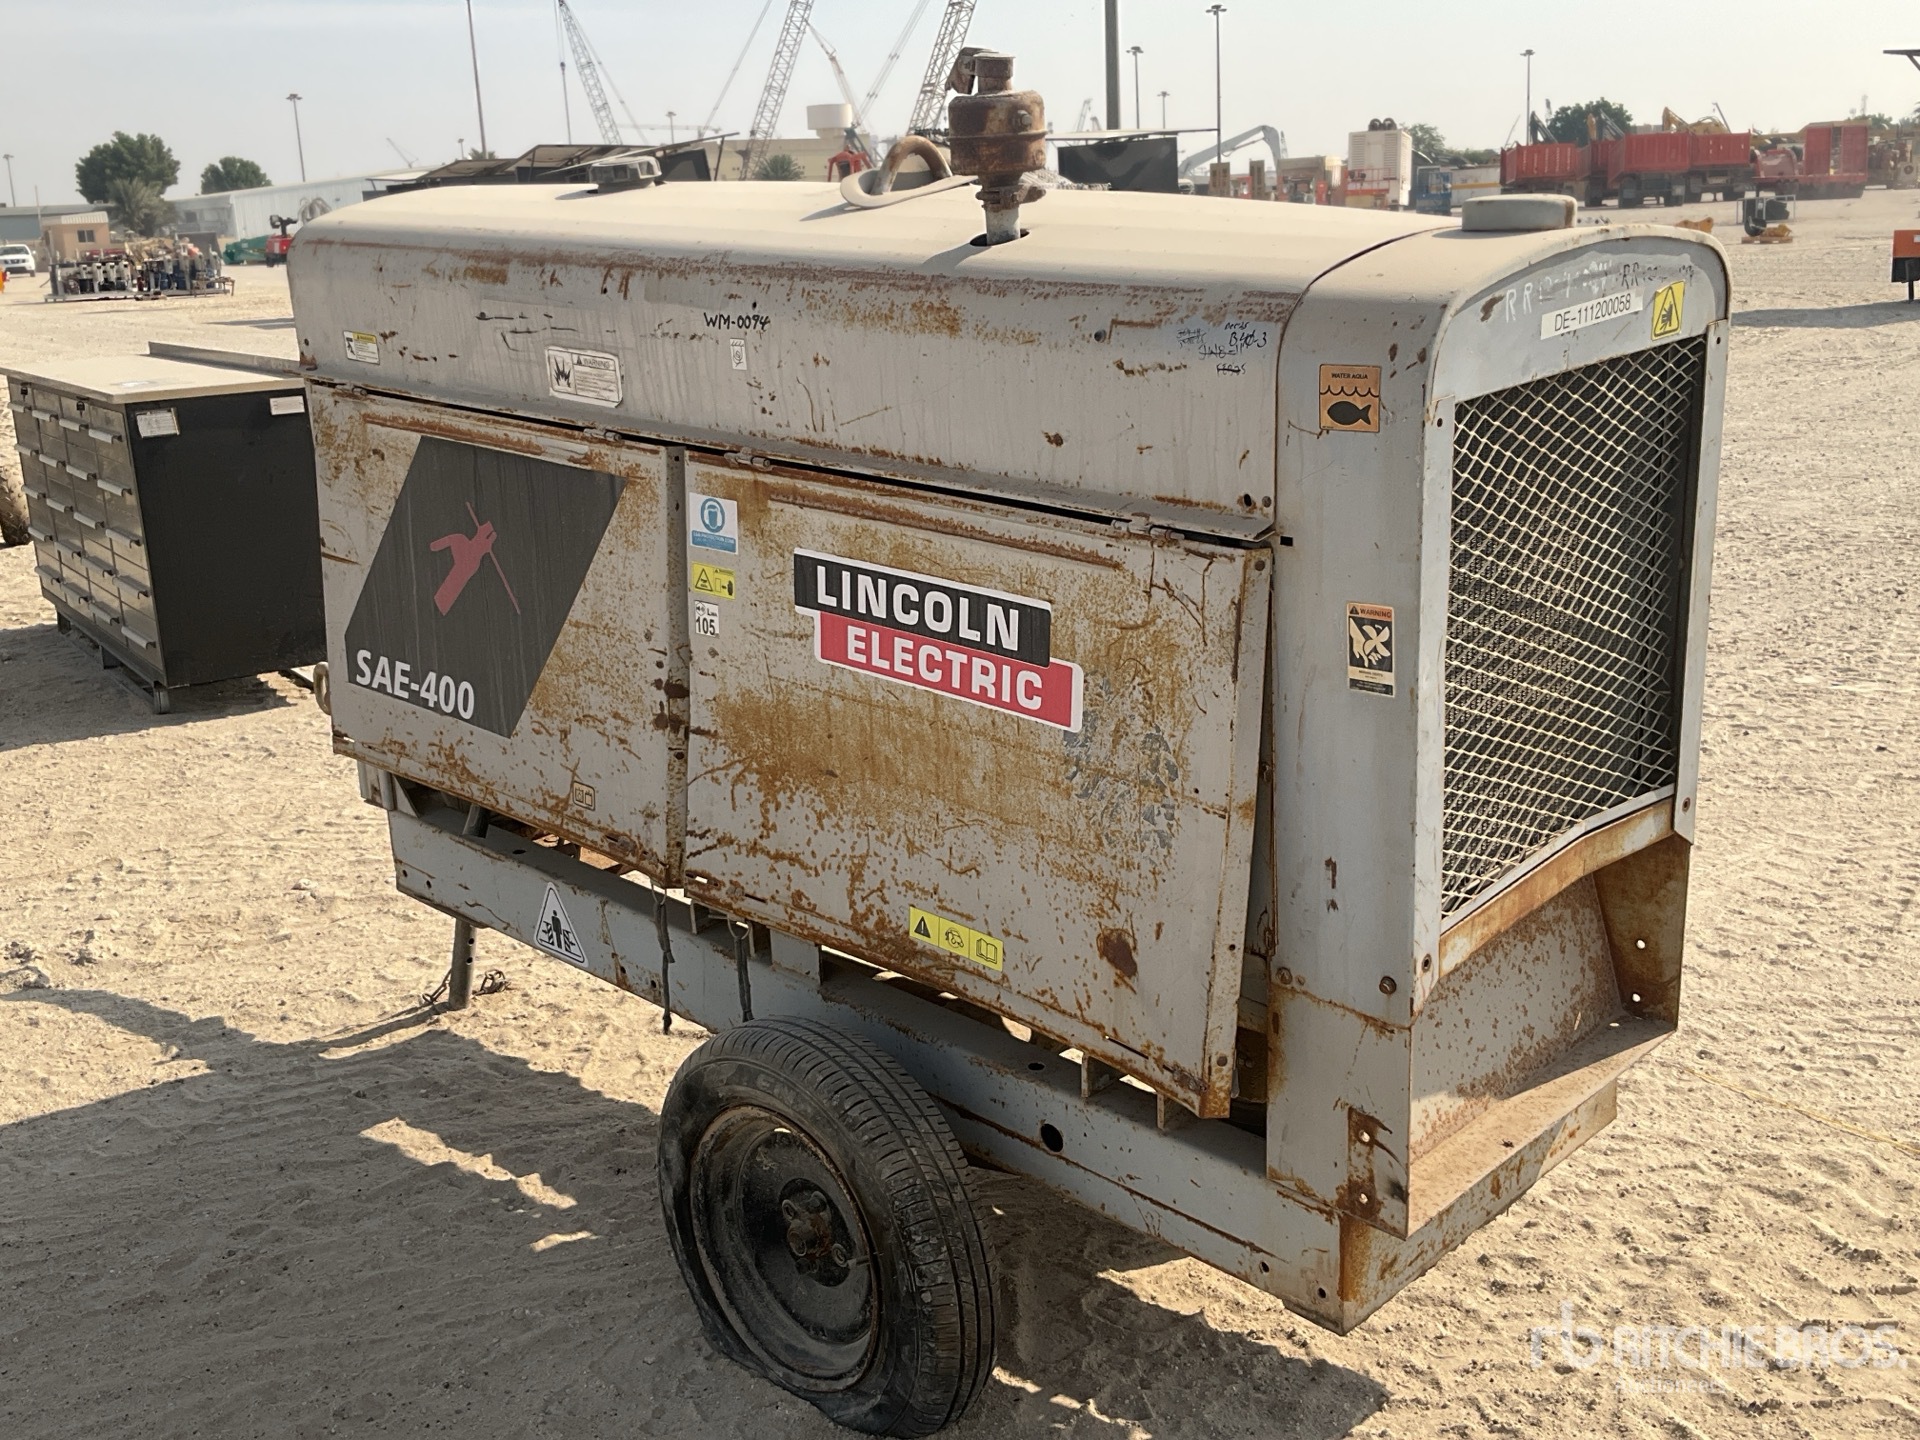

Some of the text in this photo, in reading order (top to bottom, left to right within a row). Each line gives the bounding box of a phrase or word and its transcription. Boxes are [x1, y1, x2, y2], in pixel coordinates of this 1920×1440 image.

[703, 312, 771, 330] WM-0094
[1554, 293, 1632, 332] DE-111200058
[695, 616, 716, 635] 105
[817, 565, 1019, 651] LINCOLN
[1360, 608, 1392, 618] WARNING
[356, 649, 475, 720] SAE-400
[847, 625, 1043, 710] ELECTRIC
